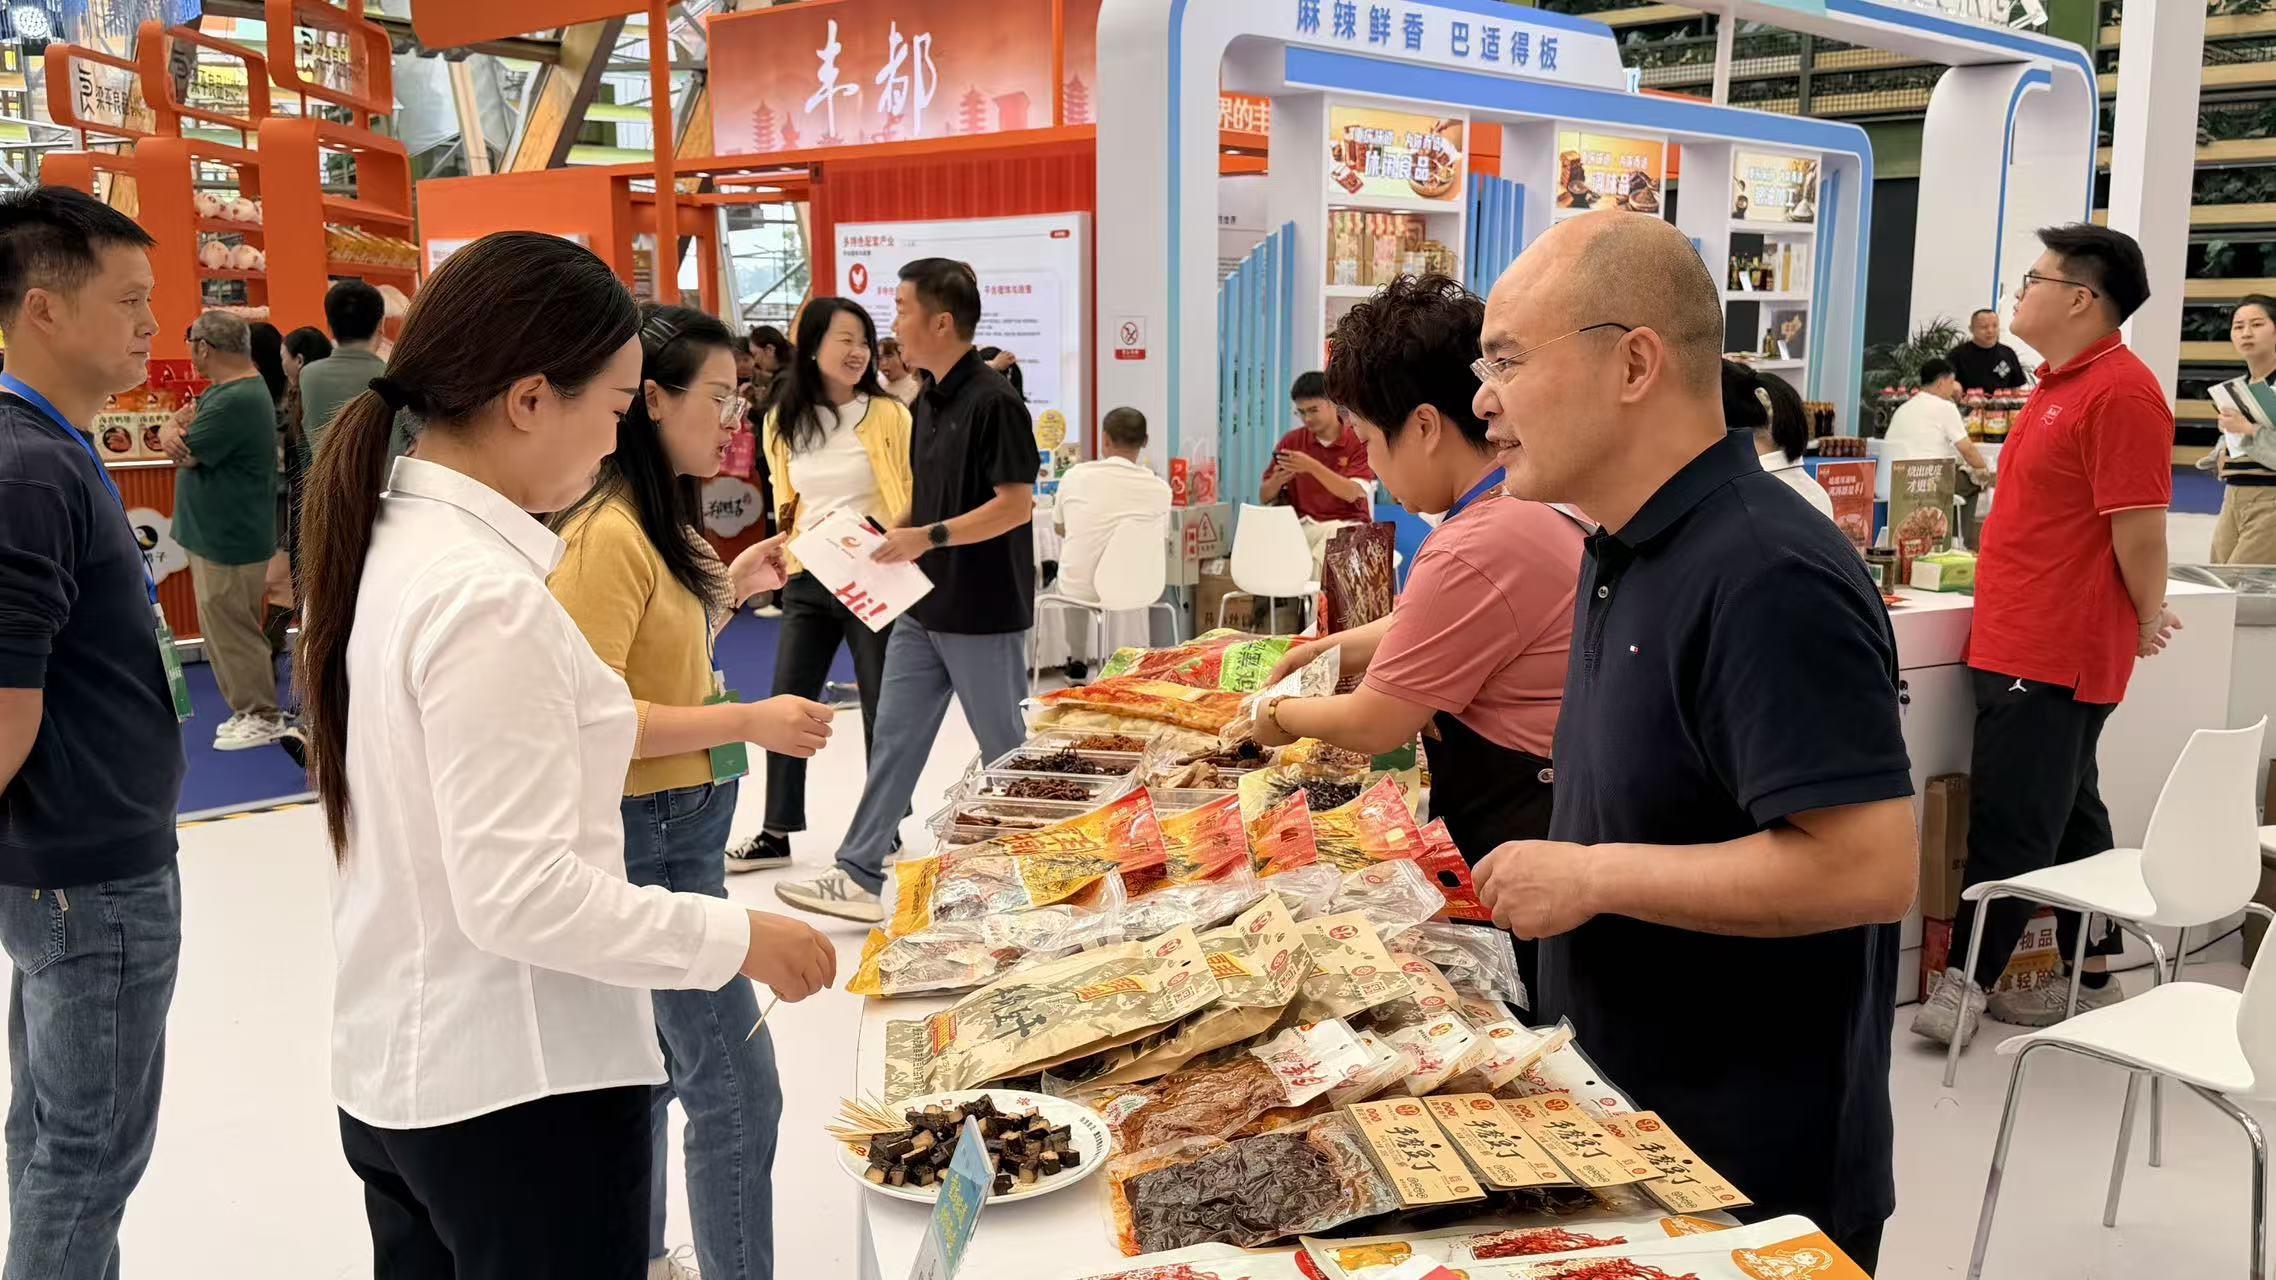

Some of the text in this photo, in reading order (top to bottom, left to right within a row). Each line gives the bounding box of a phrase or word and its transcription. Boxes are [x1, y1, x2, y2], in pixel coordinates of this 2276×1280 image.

[1296, 0, 1559, 71] 麻辣鲜香 巴适得板
[805, 18, 938, 138] 丰都
[834, 581, 889, 622] Hi!
